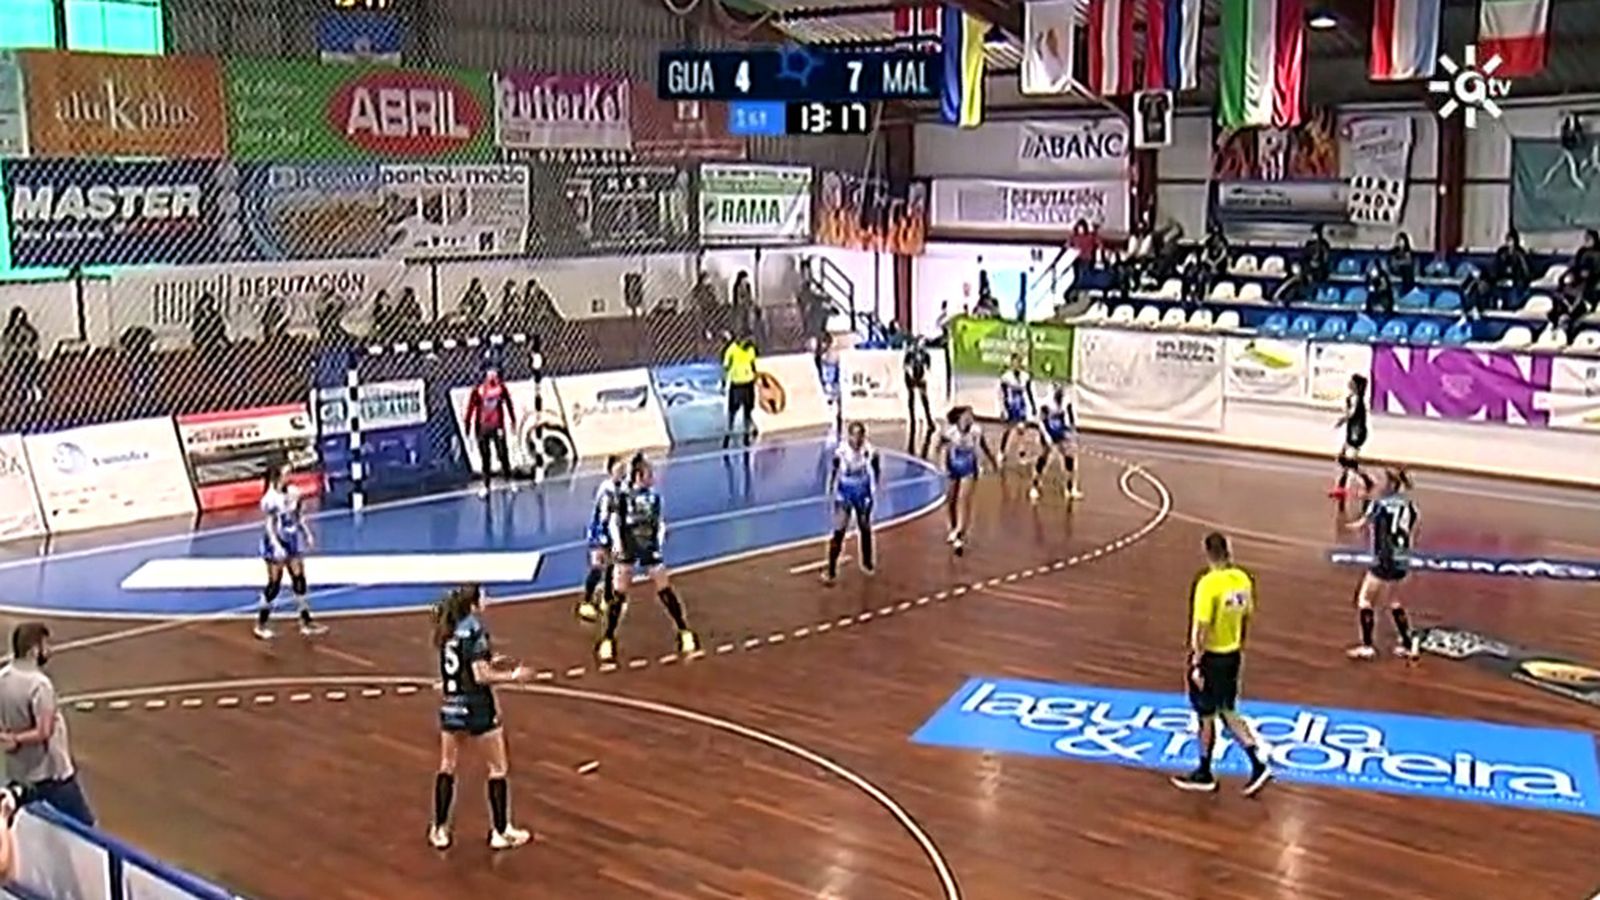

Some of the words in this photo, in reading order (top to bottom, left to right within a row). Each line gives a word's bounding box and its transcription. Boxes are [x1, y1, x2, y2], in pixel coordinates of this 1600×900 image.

[347, 86, 470, 138] ABRIL
[12, 184, 202, 221] MASTER
[721, 199, 781, 223] RAMA
[239, 270, 367, 297] DEPUTACIÓN
[961, 684, 1386, 750] laguadia
[1162, 732, 1583, 799] moreira
